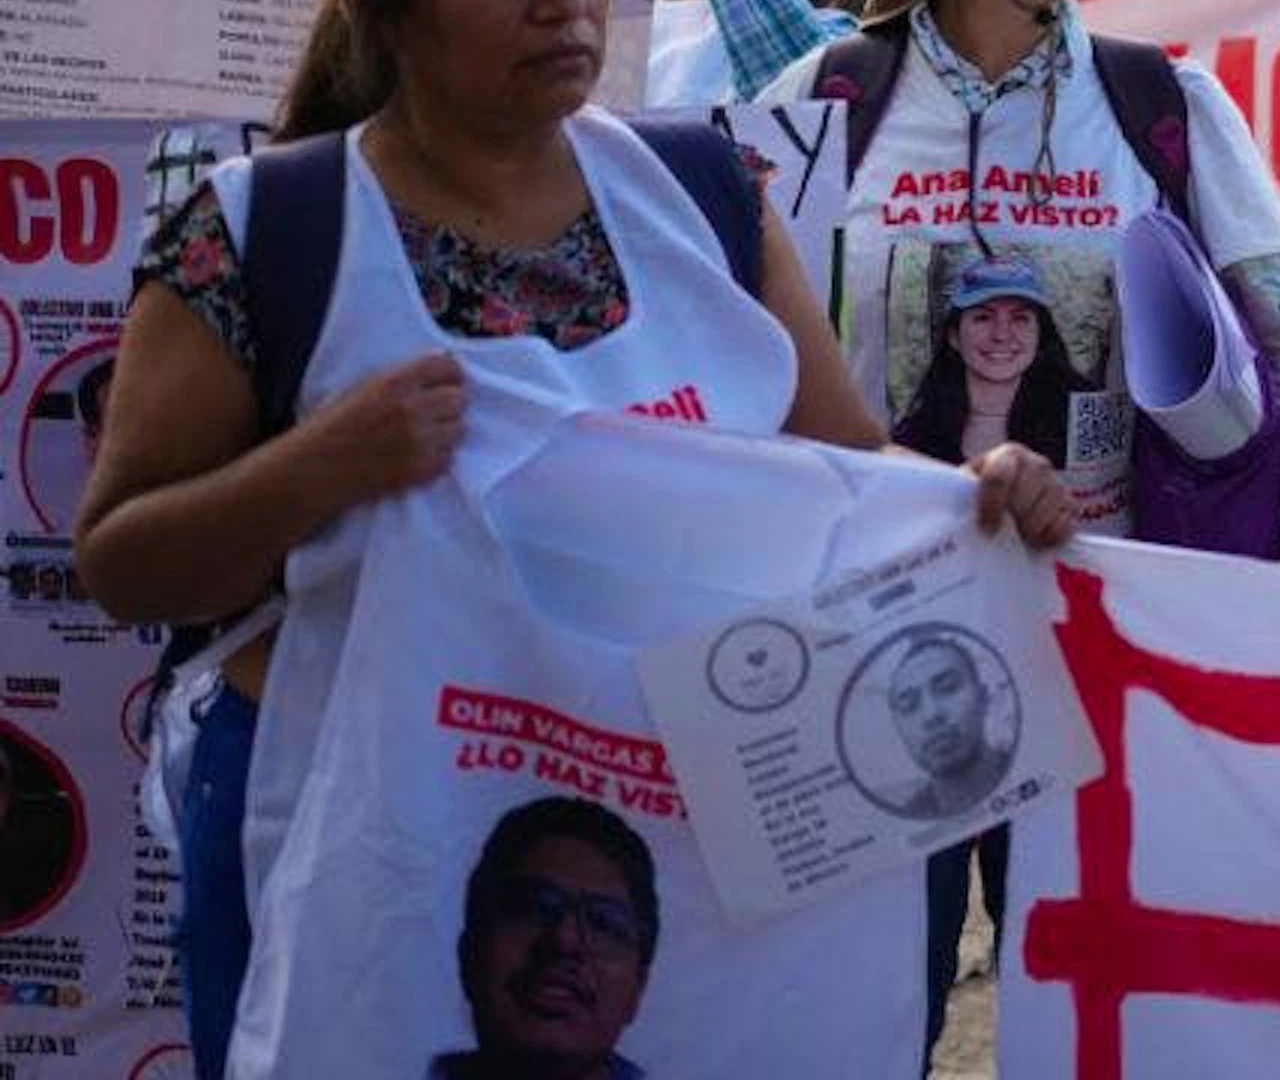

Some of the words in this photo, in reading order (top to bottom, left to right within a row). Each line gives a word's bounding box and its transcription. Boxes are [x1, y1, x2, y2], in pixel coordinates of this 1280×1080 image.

[890, 168, 970, 198] Ana
[1008, 203, 1119, 227] VISTO?
[532, 713, 657, 770] VARGAS
